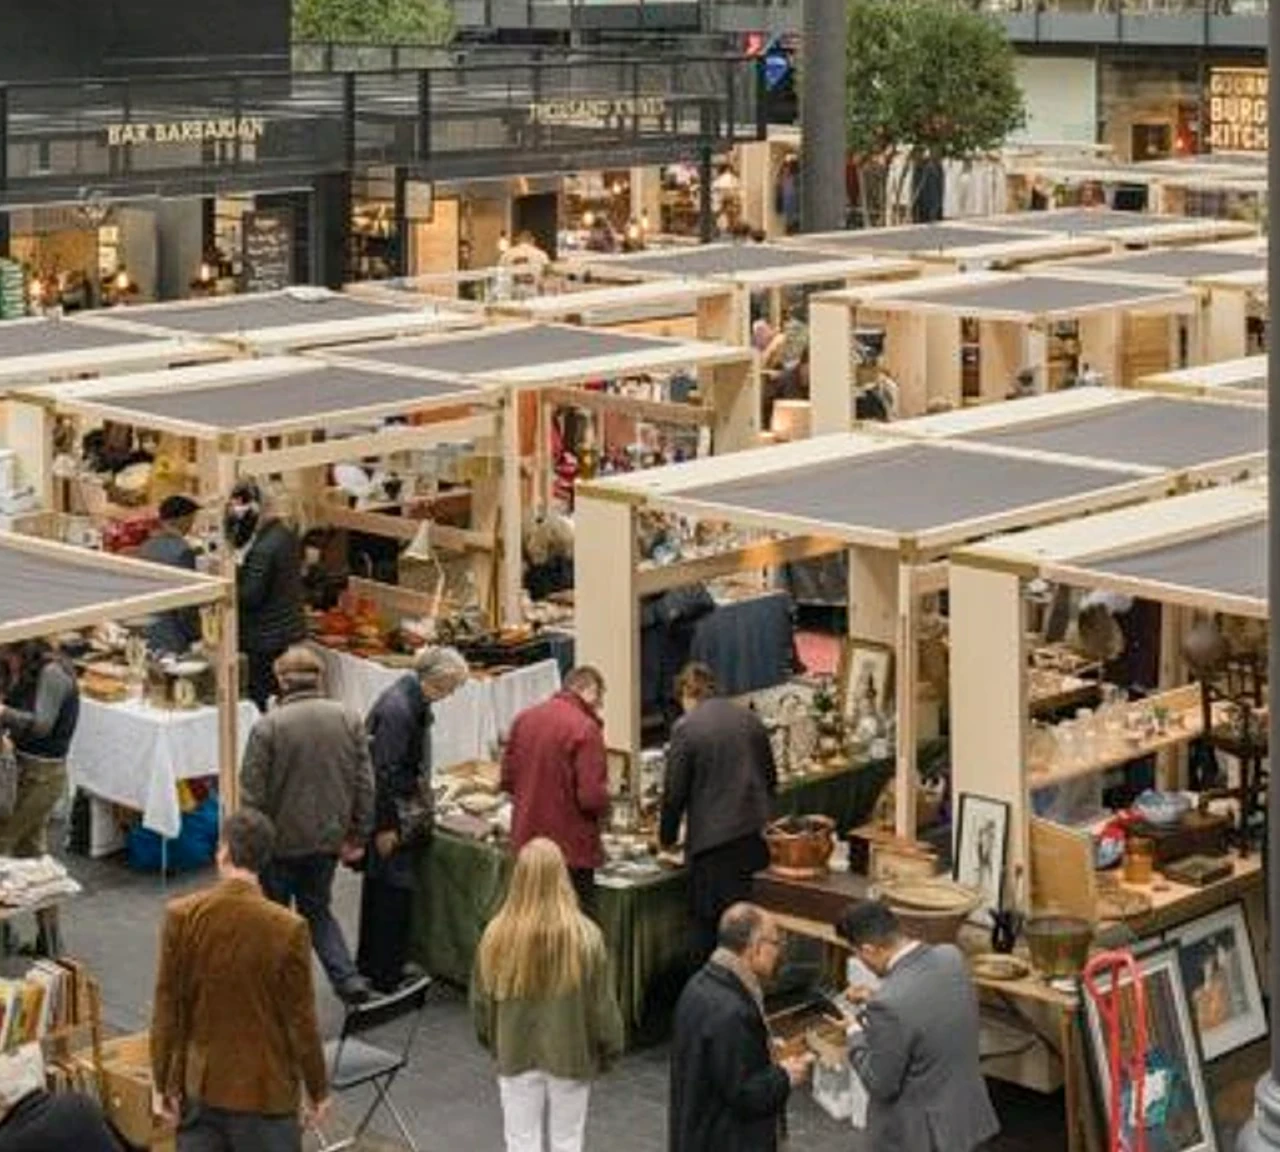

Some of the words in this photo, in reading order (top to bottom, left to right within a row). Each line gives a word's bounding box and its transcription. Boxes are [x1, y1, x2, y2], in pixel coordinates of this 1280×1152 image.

[1210, 74, 1268, 95] GOURM
[1211, 97, 1267, 124] BURG
[108, 124, 149, 145] BAR
[1210, 124, 1268, 148] KITCH
